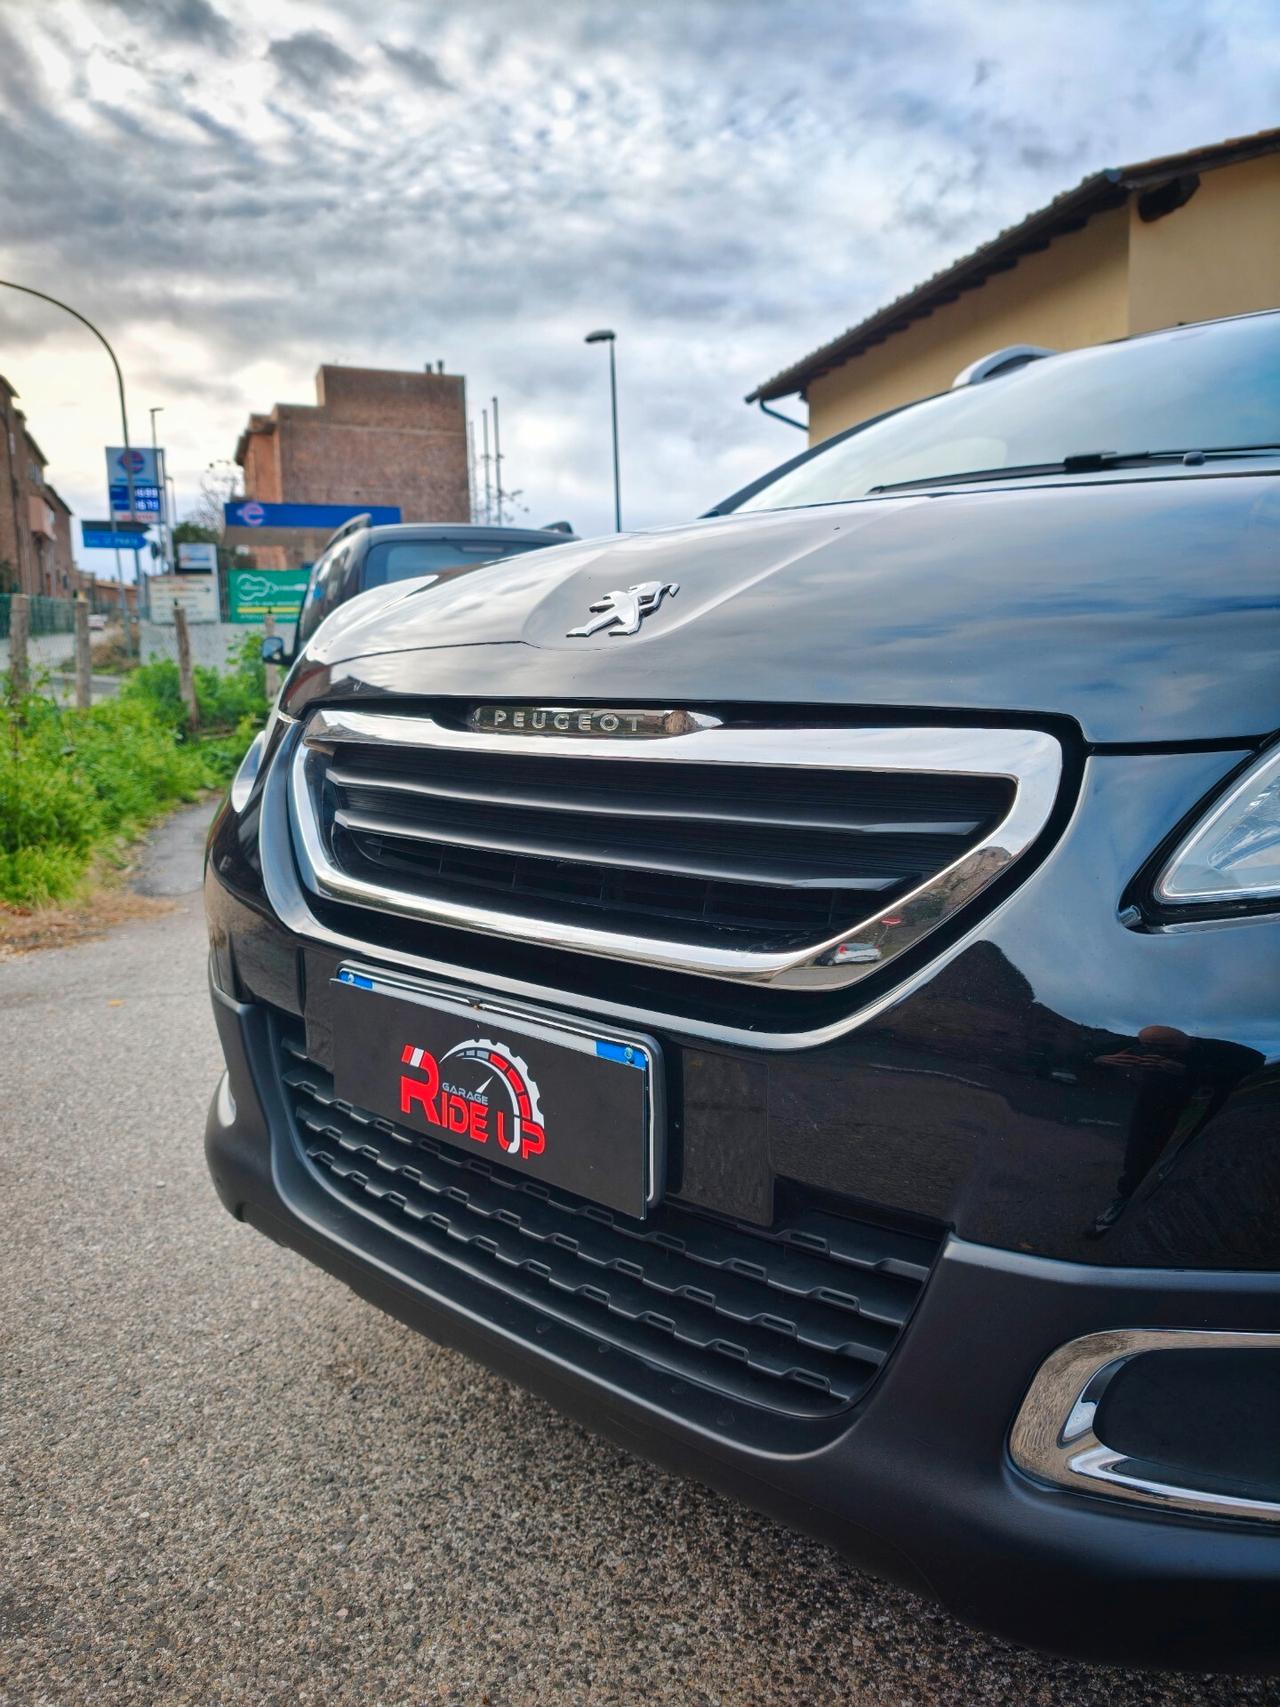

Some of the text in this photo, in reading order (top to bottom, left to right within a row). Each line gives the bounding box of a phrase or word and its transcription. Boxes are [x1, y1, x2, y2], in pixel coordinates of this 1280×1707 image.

[493, 709, 644, 732] PEUGEOT
[400, 1043, 546, 1160] RIDE UP
[441, 1082, 489, 1106] GARAGE
